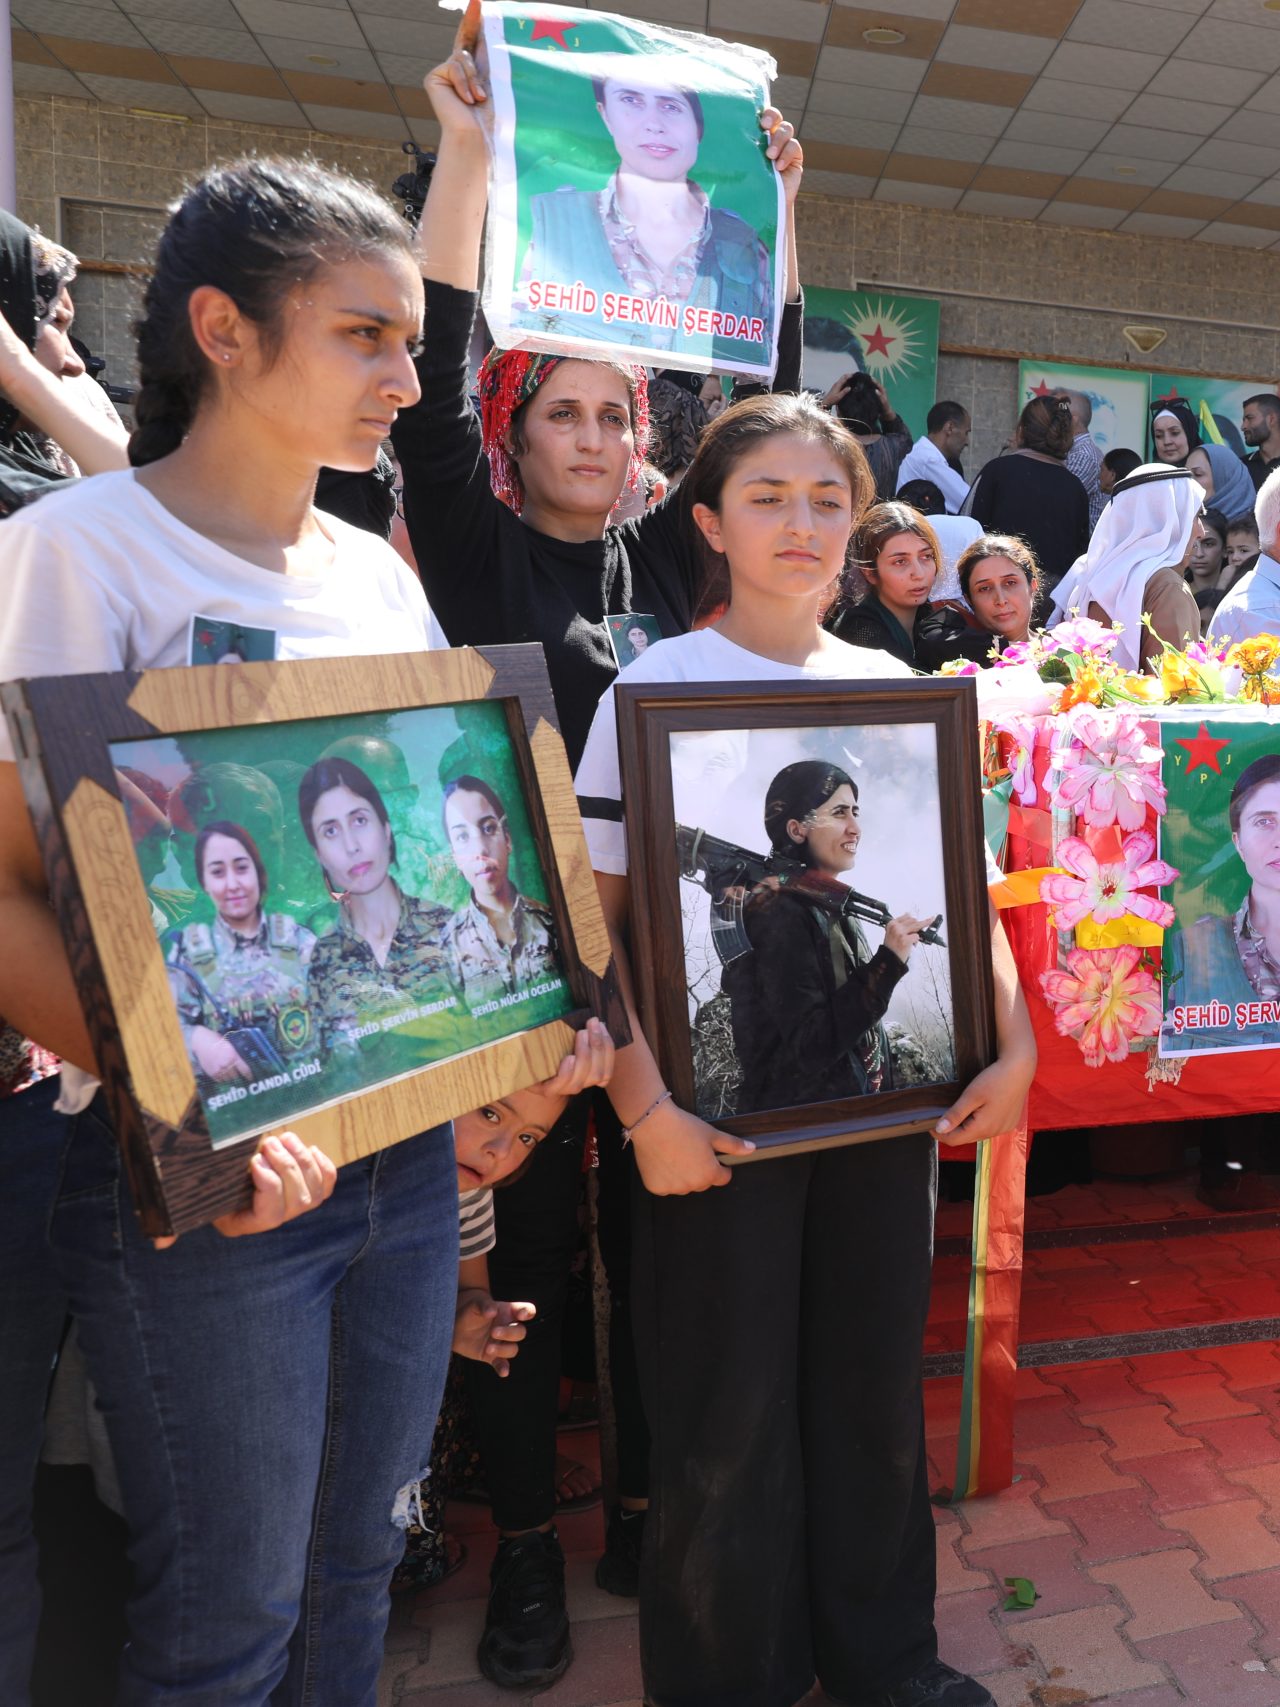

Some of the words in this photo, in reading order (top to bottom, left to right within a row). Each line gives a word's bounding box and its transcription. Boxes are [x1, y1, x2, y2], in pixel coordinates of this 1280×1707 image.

[517, 18, 526, 30] Y
[527, 280, 597, 314] ŞEHÎD
[602, 293, 680, 329] ŞERVÎN
[684, 306, 765, 343] ŞERDAR
[1174, 755, 1182, 766] Y
[1226, 754, 1232, 765] J
[1200, 773, 1208, 784] P
[1173, 1001, 1231, 1033] ŞEHÎD
[248, 1072, 292, 1095] CANDA
